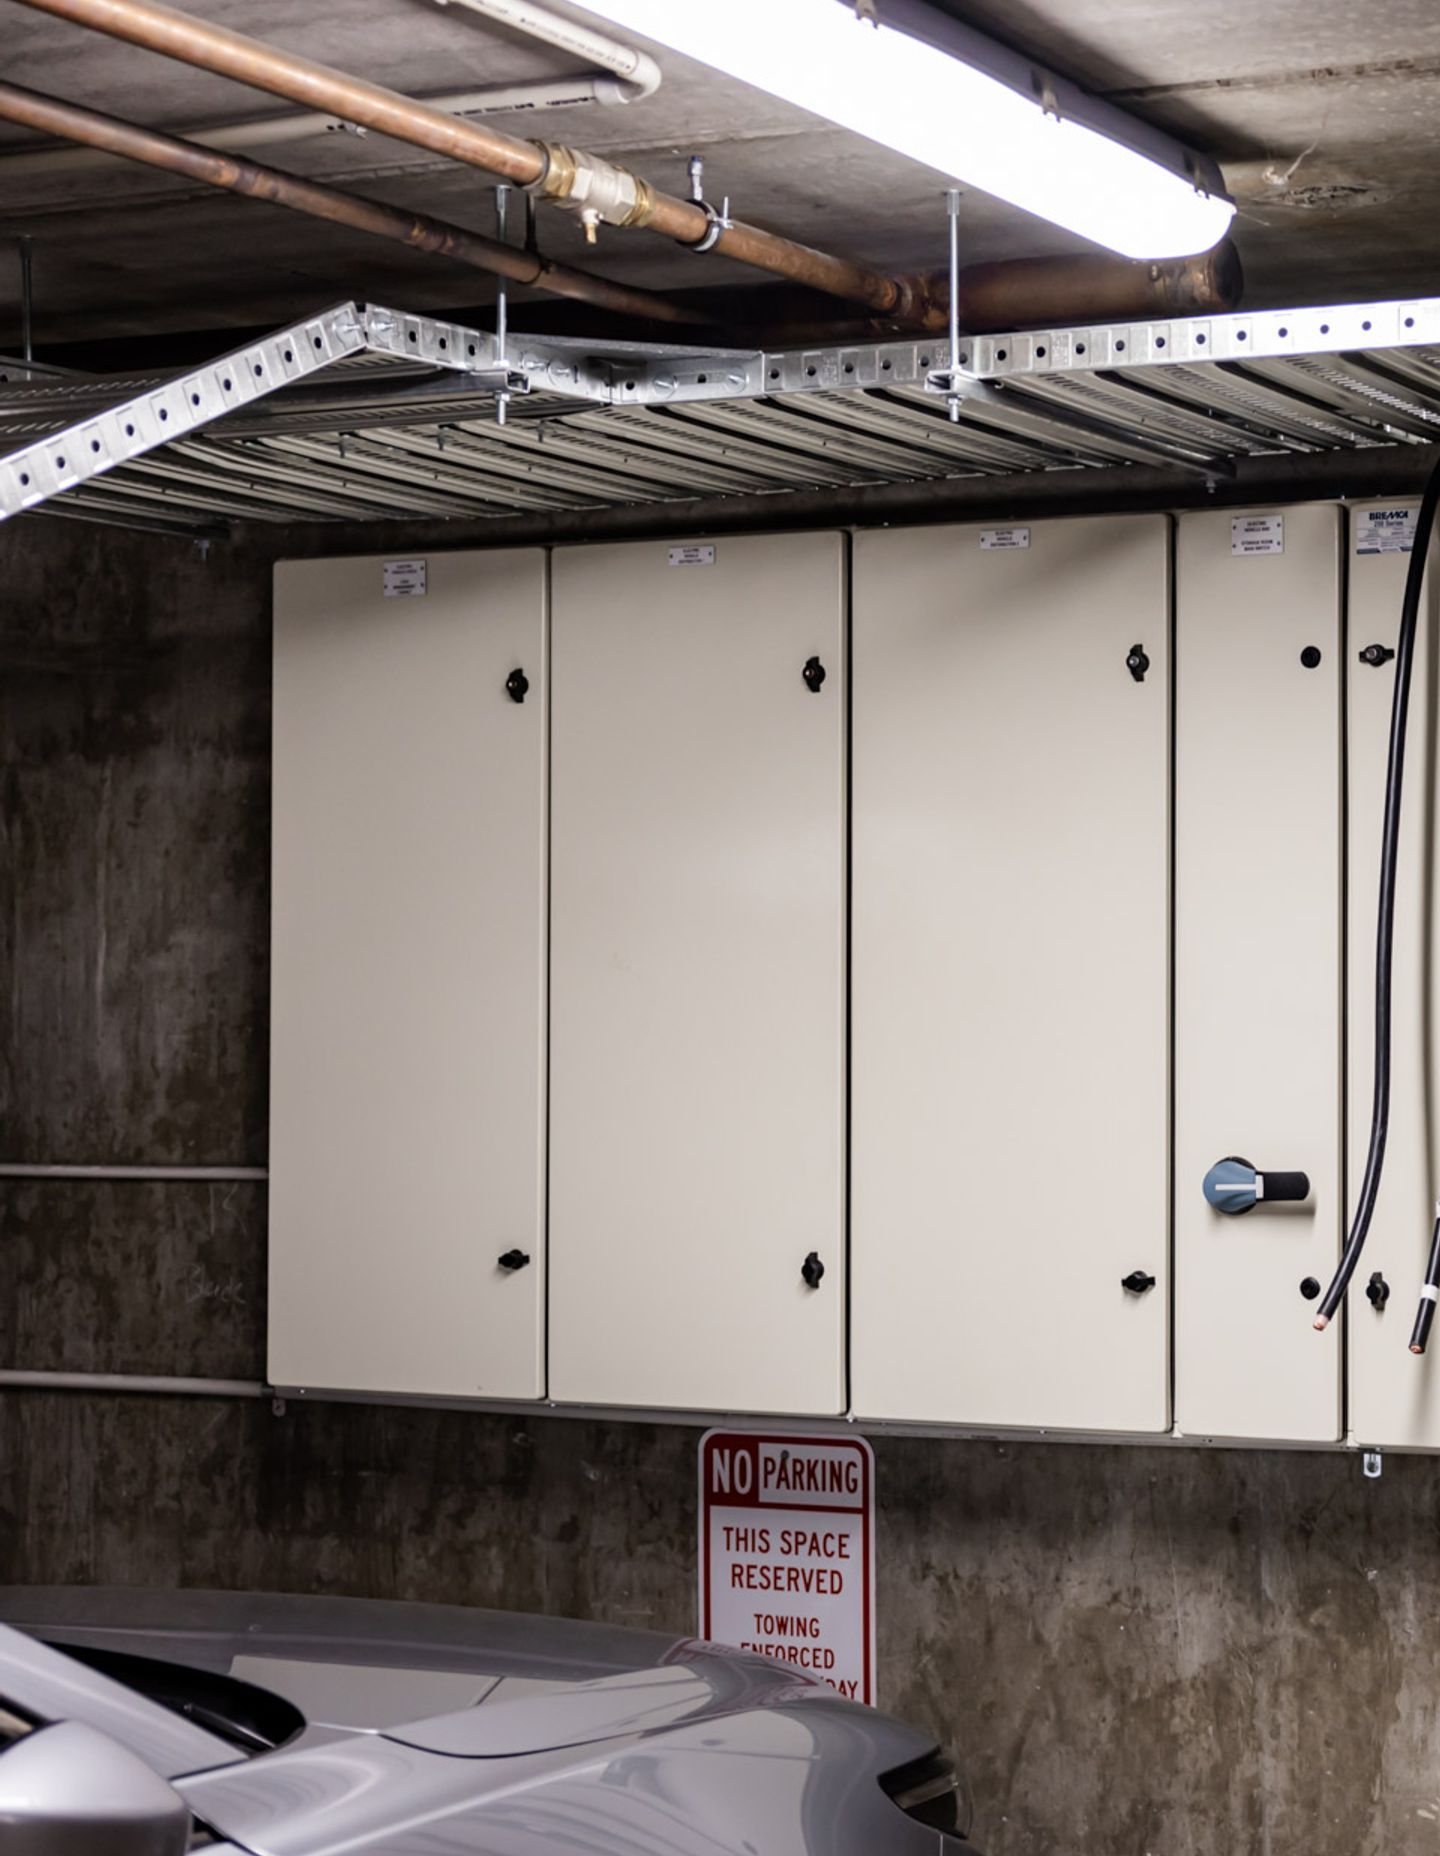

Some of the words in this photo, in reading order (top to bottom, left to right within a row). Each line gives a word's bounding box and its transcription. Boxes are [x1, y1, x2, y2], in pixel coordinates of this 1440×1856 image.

[712, 1447, 753, 1495] NO
[763, 1456, 858, 1494] PARKING
[722, 1526, 770, 1554] THIS
[780, 1531, 851, 1559] SPACE
[731, 1563, 843, 1595] RESERVED
[753, 1613, 820, 1638] TOWING
